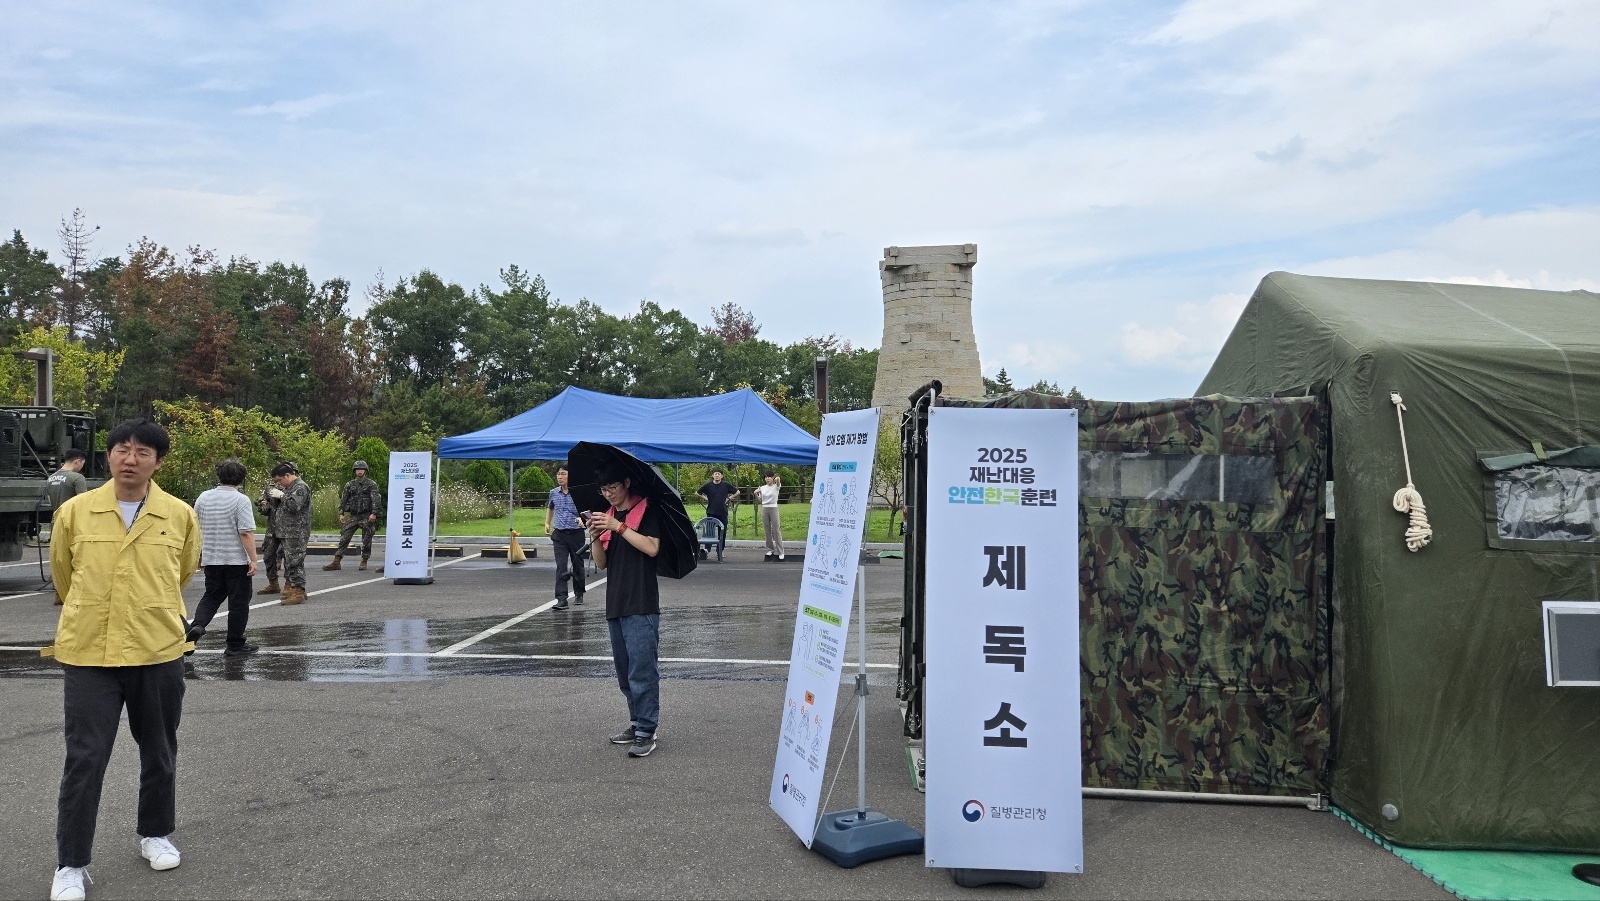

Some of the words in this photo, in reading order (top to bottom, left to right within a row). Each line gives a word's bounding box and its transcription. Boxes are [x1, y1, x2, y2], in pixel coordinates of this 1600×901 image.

[836, 434, 846, 445] 오염
[846, 433, 856, 444] 제거
[857, 432, 868, 444] 방법
[977, 447, 1028, 464] 2025
[969, 467, 1036, 484] 재난대응
[948, 486, 1057, 506] 안전한국훈련
[402, 487, 414, 548] 응급의료소
[982, 545, 1028, 748] 제독소
[990, 806, 1047, 821] 질병관리청
